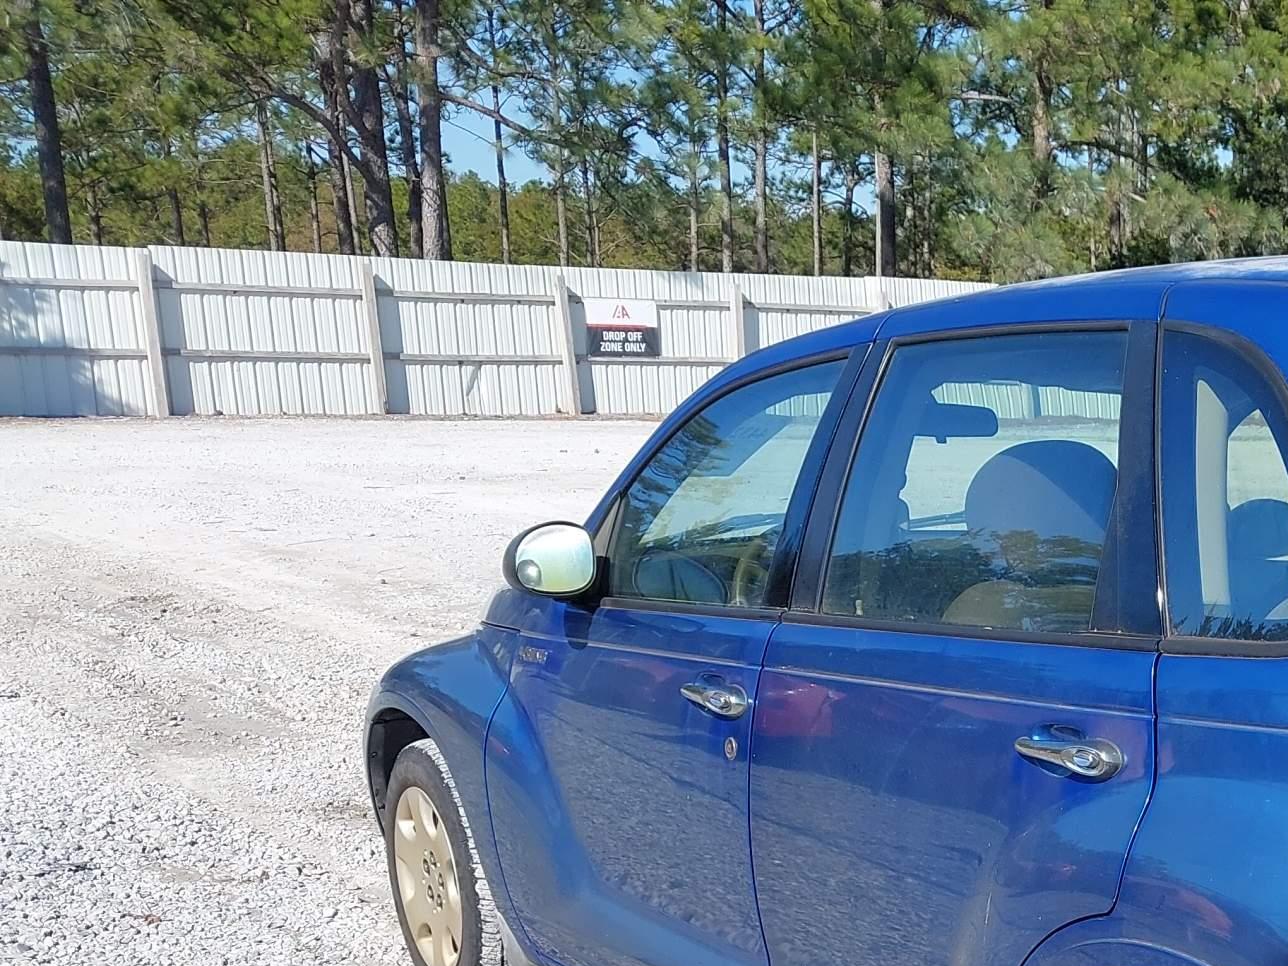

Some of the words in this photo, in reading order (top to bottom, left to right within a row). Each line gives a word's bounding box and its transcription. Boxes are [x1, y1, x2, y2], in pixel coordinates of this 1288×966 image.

[602, 331, 626, 341] DROP
[627, 331, 643, 341] OFF
[600, 342, 623, 352] ZONE
[624, 342, 646, 352] ONLY
